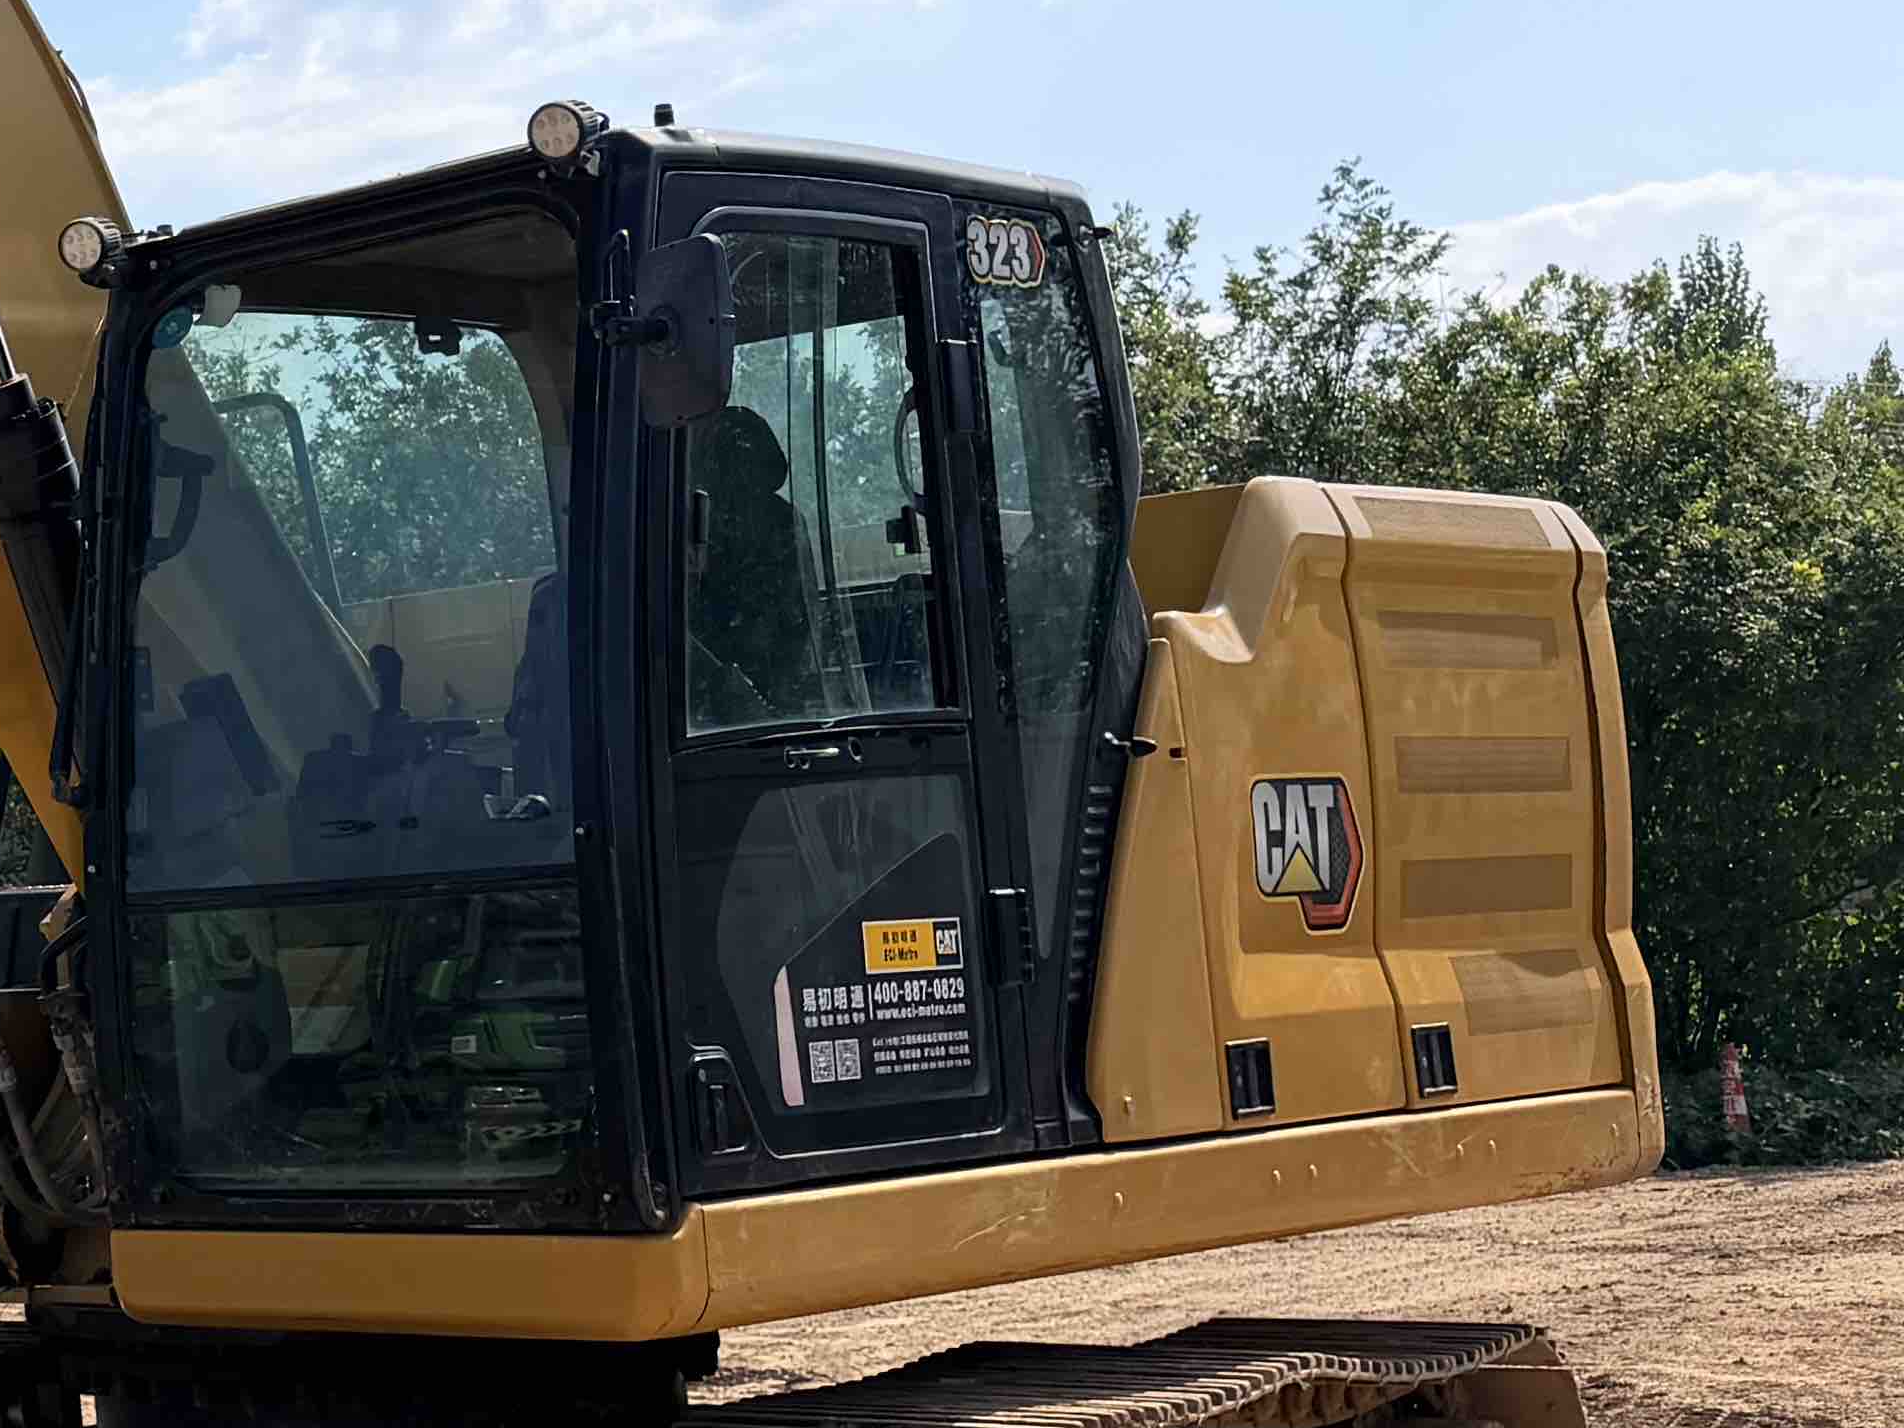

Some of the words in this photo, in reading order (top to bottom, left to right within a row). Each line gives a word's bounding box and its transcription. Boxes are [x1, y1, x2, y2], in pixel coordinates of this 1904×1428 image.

[966, 219, 1031, 281] 323
[1251, 781, 1335, 894] CAT
[935, 929, 958, 955] CAT
[802, 985, 866, 1013] 易初明通
[873, 977, 966, 1005] 400-887-0829
